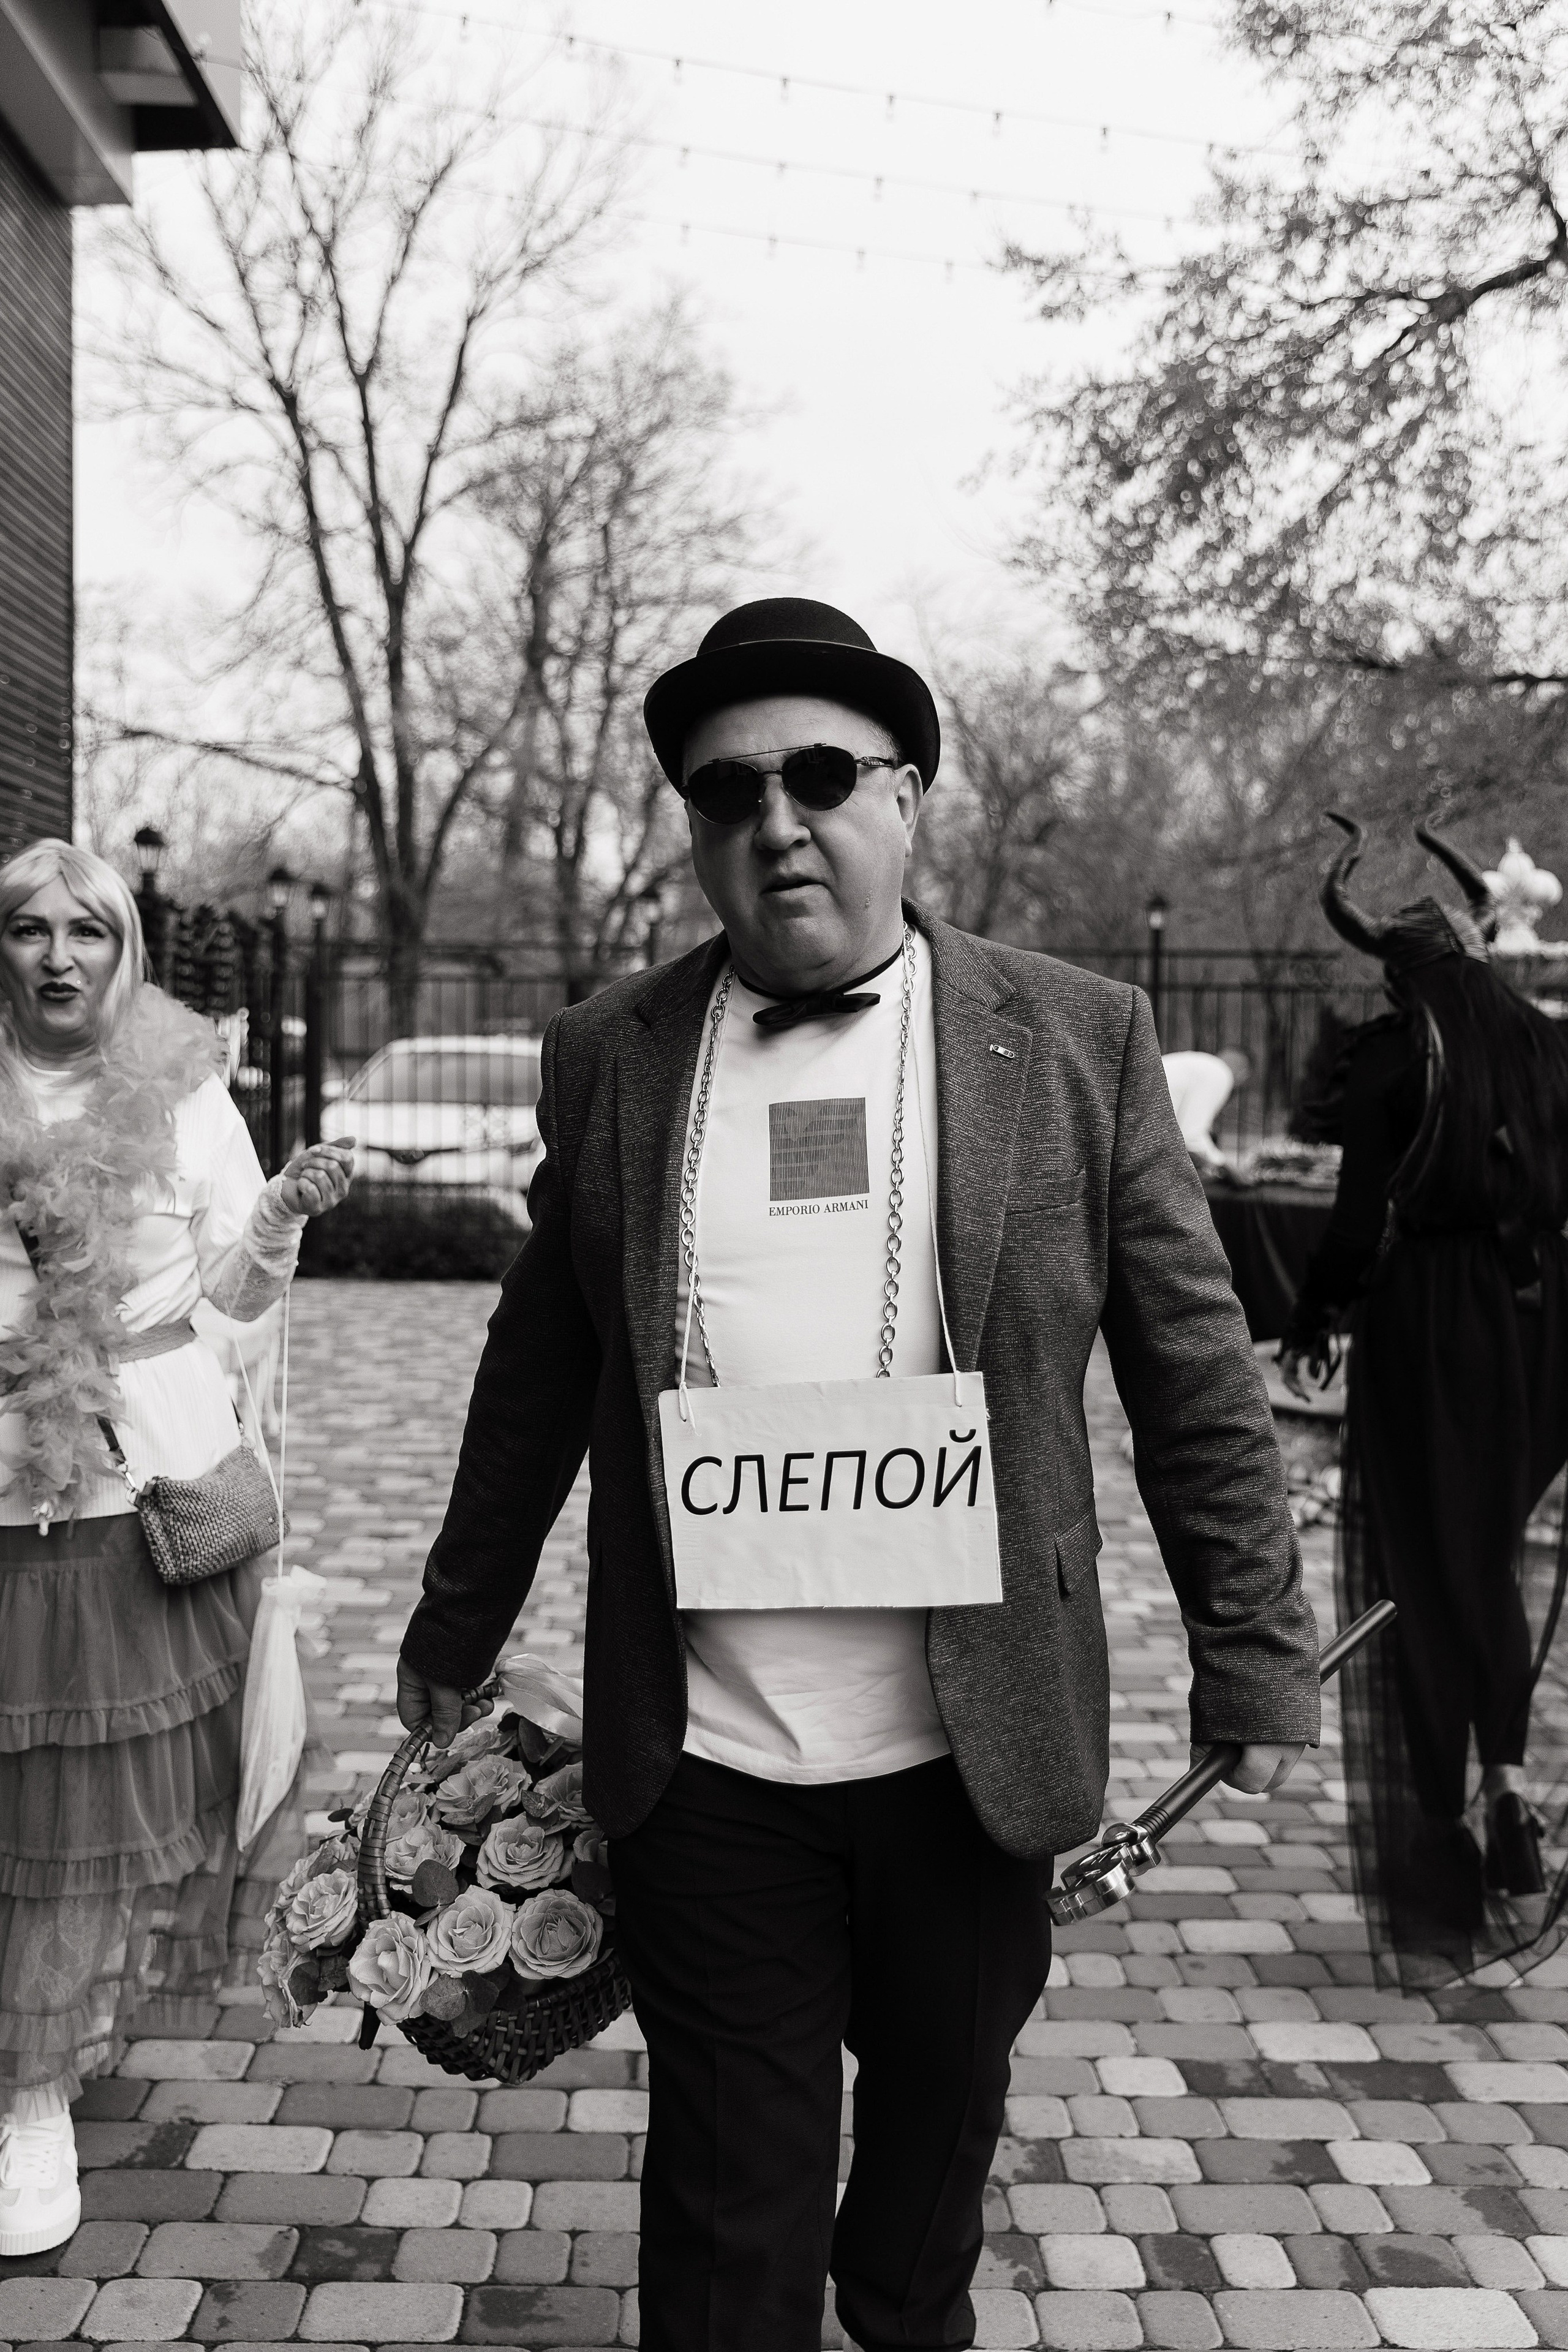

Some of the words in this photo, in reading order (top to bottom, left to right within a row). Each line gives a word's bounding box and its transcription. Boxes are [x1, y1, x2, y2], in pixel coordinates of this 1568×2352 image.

[769, 1204, 820, 1216] EMPORIO
[824, 1199, 869, 1213] ARMANI
[680, 1428, 982, 1515] СЛЕПОЙ
